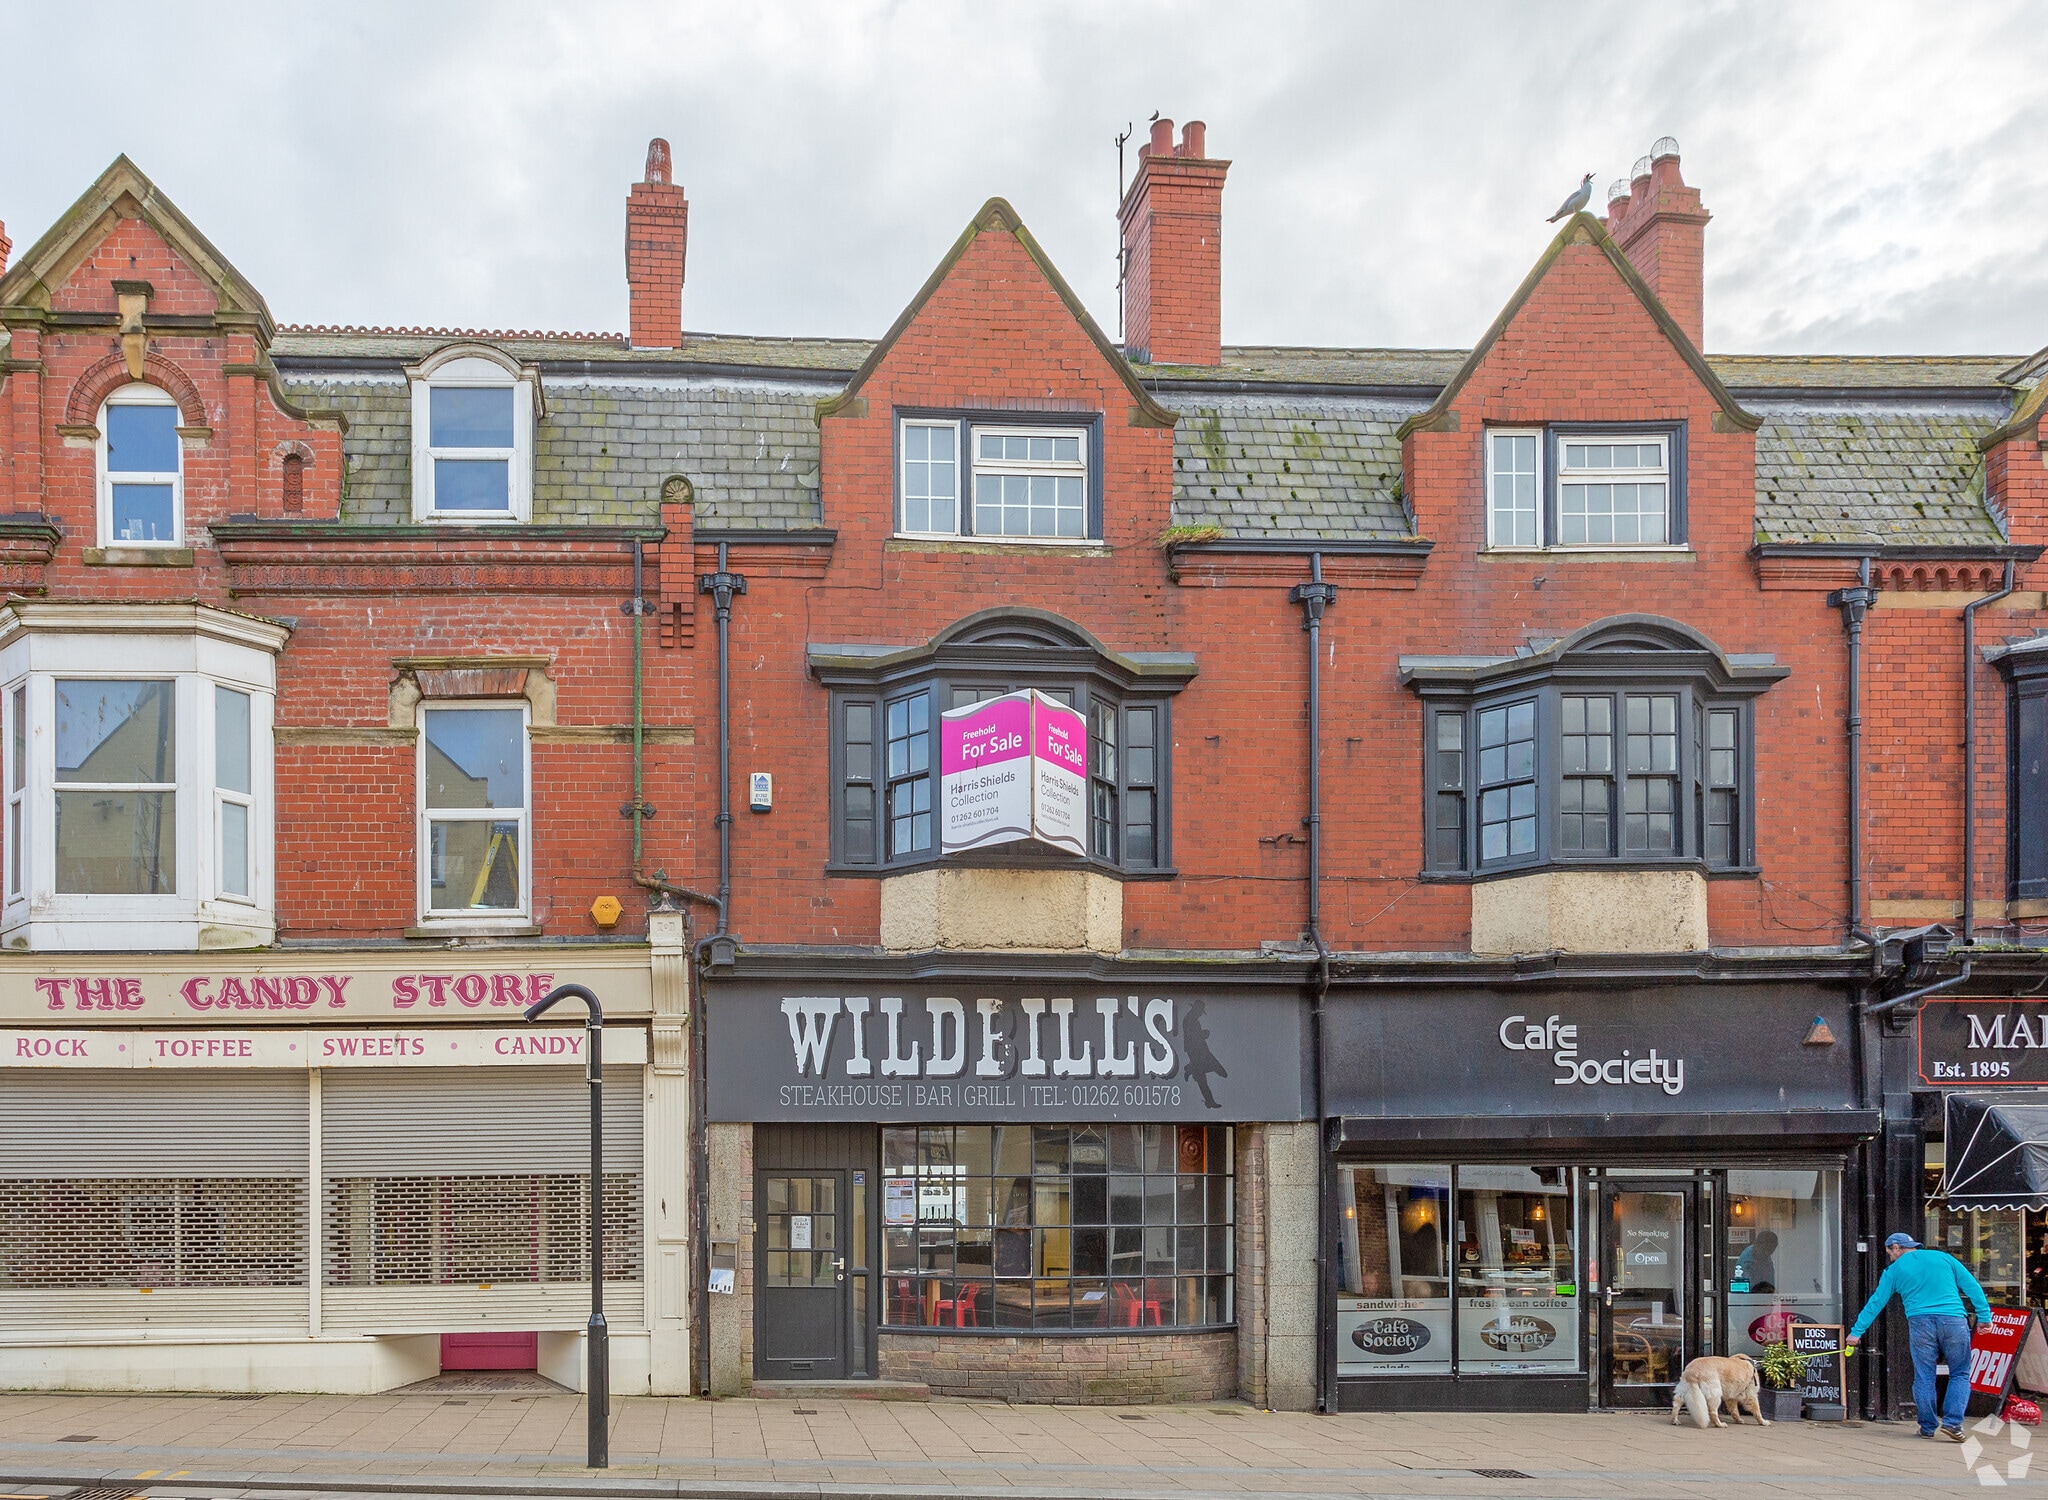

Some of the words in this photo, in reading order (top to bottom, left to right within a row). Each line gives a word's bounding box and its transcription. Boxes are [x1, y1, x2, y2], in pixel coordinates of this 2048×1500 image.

[963, 724, 996, 740] Freehold
[1048, 723, 1068, 739] Freehold
[962, 743, 987, 760] For
[989, 732, 1022, 753] Sale
[1048, 736, 1063, 757] For
[1064, 744, 1083, 766] Sale
[950, 780, 979, 794] Harris
[980, 772, 1016, 788] Shields
[1041, 770, 1059, 787] Harris
[1059, 779, 1079, 796] Shields
[951, 790, 999, 807] Collection
[1041, 784, 1071, 805] Collection
[951, 812, 972, 823] 01262
[973, 806, 999, 818] 601704
[1041, 803, 1055, 815] 01262
[1055, 807, 1071, 820] 601704
[35, 976, 146, 1011] THE
[180, 975, 354, 1011] CANDY
[391, 973, 555, 1008] STORE
[1500, 1015, 1577, 1050] Cafe
[1967, 1014, 2048, 1048] MA
[15, 1038, 89, 1058] ROCK
[155, 1039, 253, 1057] TOFFEE
[323, 1038, 425, 1056] SWEETS
[494, 1036, 584, 1055] CANDY
[1554, 1049, 1684, 1095] Society
[1932, 1061, 1966, 1077] Est.
[1970, 1061, 2010, 1077] 1895
[780, 1085, 902, 1106] STEAKHOUSE
[915, 1085, 952, 1106] BAR
[964, 1085, 1016, 1106] GRILL
[1030, 1085, 1068, 1106] TEL:
[1072, 1085, 1119, 1106] 01262
[1124, 1085, 1181, 1106] 601578
[1638, 1229, 1669, 1239] Smoking
[1635, 1253, 1659, 1265] Open
[1532, 1298, 1568, 1308] coffee
[1773, 1295, 1798, 1303] soup
[1804, 1328, 1826, 1338] DOGS
[1991, 1323, 2015, 1336] hoes
[1363, 1333, 1420, 1351] Society
[1488, 1331, 1548, 1348] Society
[1794, 1339, 1838, 1349] WELCOME
